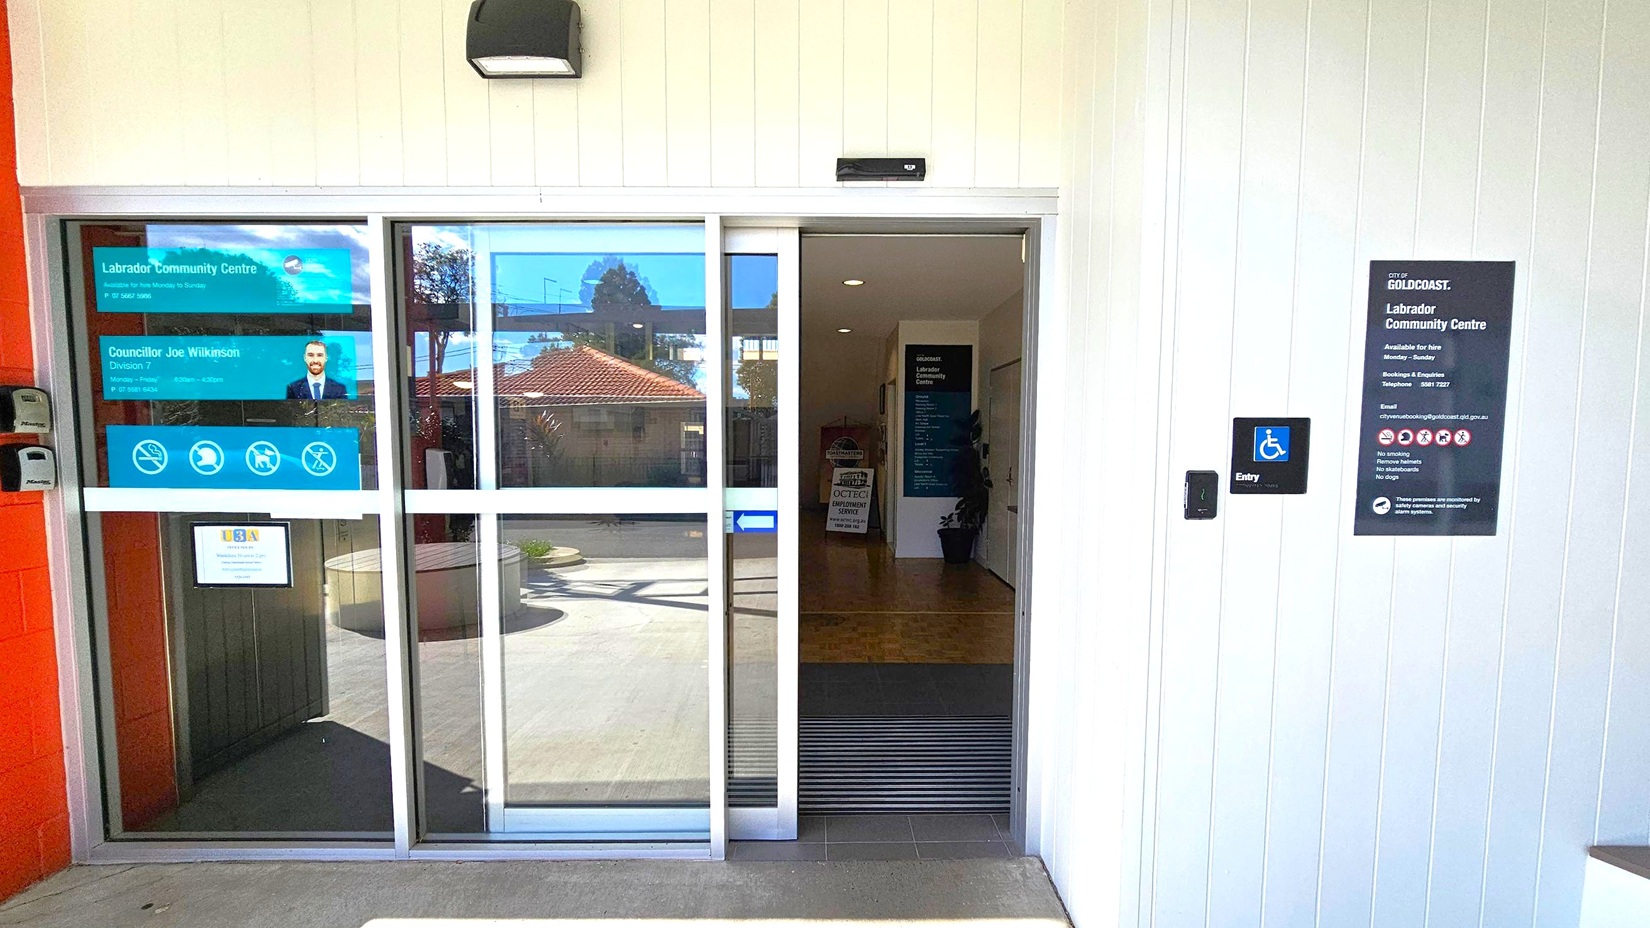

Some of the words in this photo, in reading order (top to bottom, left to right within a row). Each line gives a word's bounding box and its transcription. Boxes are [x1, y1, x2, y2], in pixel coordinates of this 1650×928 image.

[102, 262, 151, 274] Labrador
[155, 262, 217, 276] Community
[220, 263, 257, 275] Centre
[152, 282, 175, 290] Monday
[184, 282, 206, 290] Sunday
[1386, 303, 1436, 314] Labrador
[1385, 318, 1448, 331] Community
[1451, 319, 1487, 330] Centre
[108, 346, 163, 358] Councillor
[165, 347, 185, 358] Joe
[187, 347, 240, 358] Wilkinson
[109, 361, 145, 370] Division
[145, 361, 151, 370] 7
[110, 376, 133, 384] Monday
[1235, 472, 1260, 482] Entry
[833, 490, 866, 498] OCTEC
